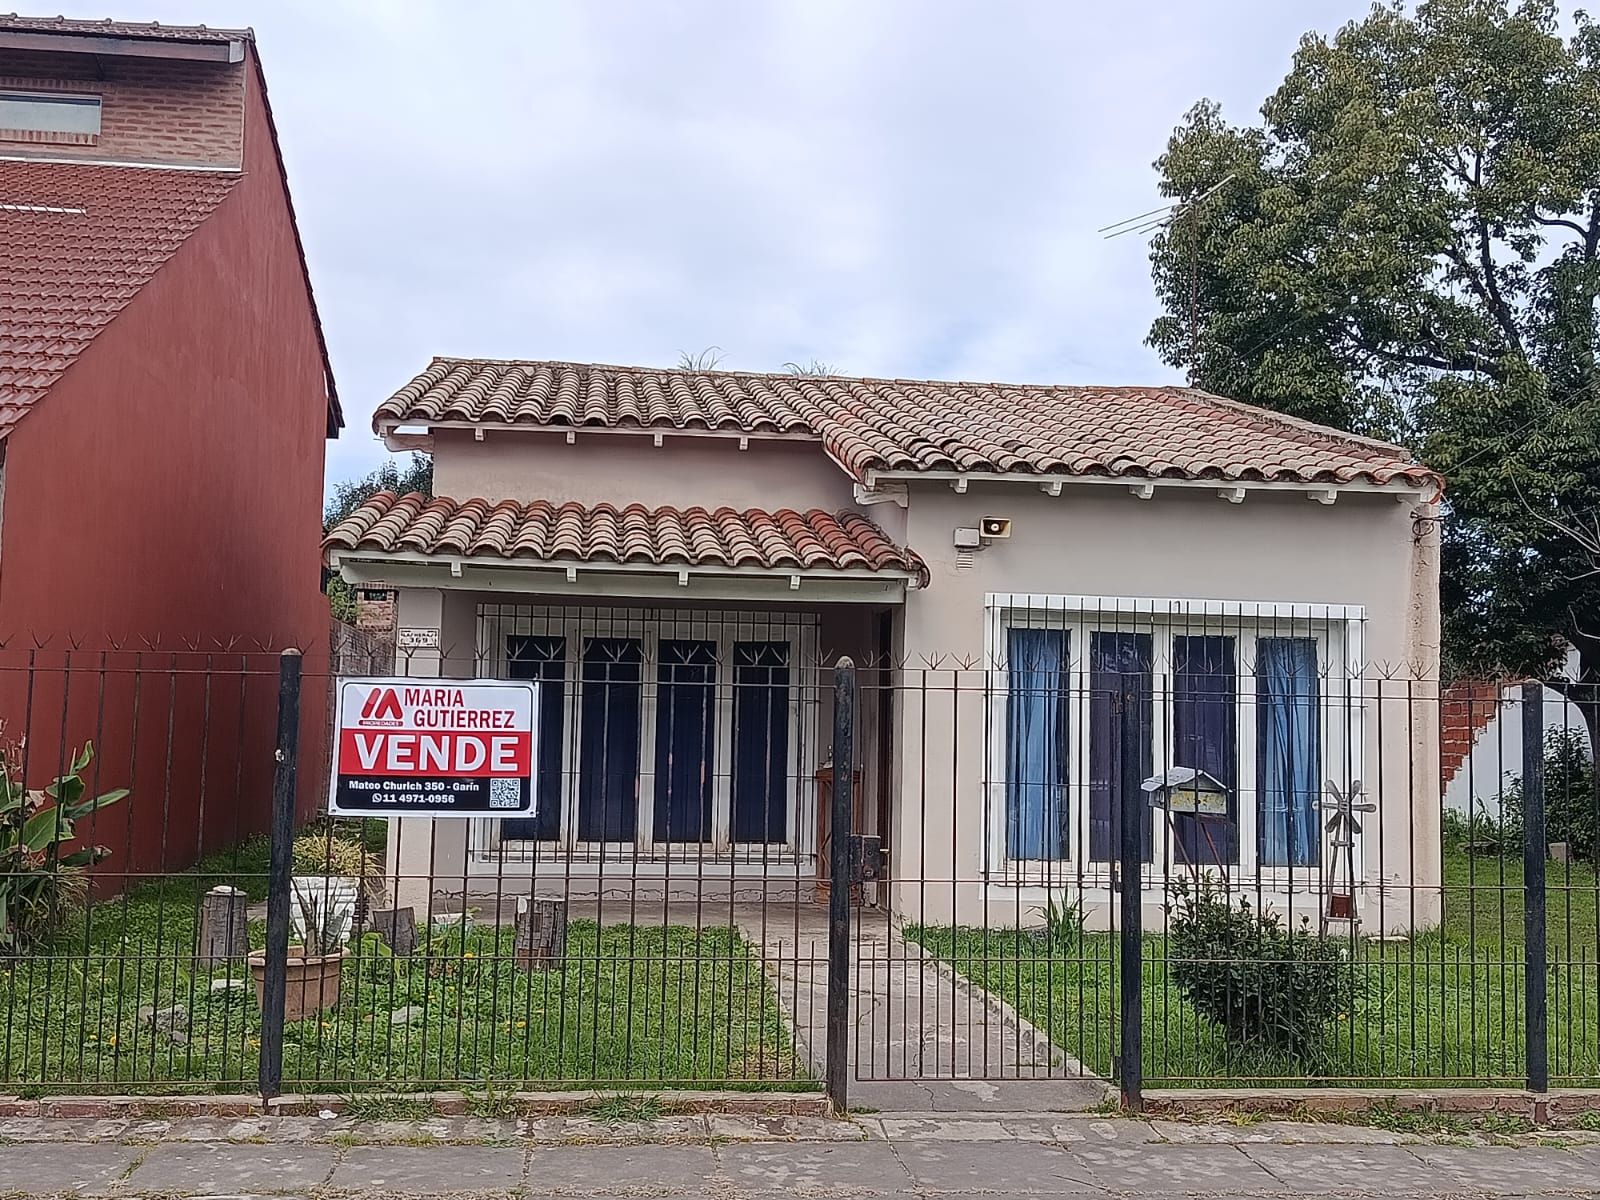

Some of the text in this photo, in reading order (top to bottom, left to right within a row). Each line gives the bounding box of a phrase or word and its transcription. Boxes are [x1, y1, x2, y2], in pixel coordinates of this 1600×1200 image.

[404, 688, 464, 707] MARIA
[413, 709, 515, 728] GUTIERREZ
[353, 733, 519, 772] VENDE
[348, 780, 381, 791] Mateo
[424, 781, 445, 791] 350
[382, 794, 455, 803] 11 4971-0956
